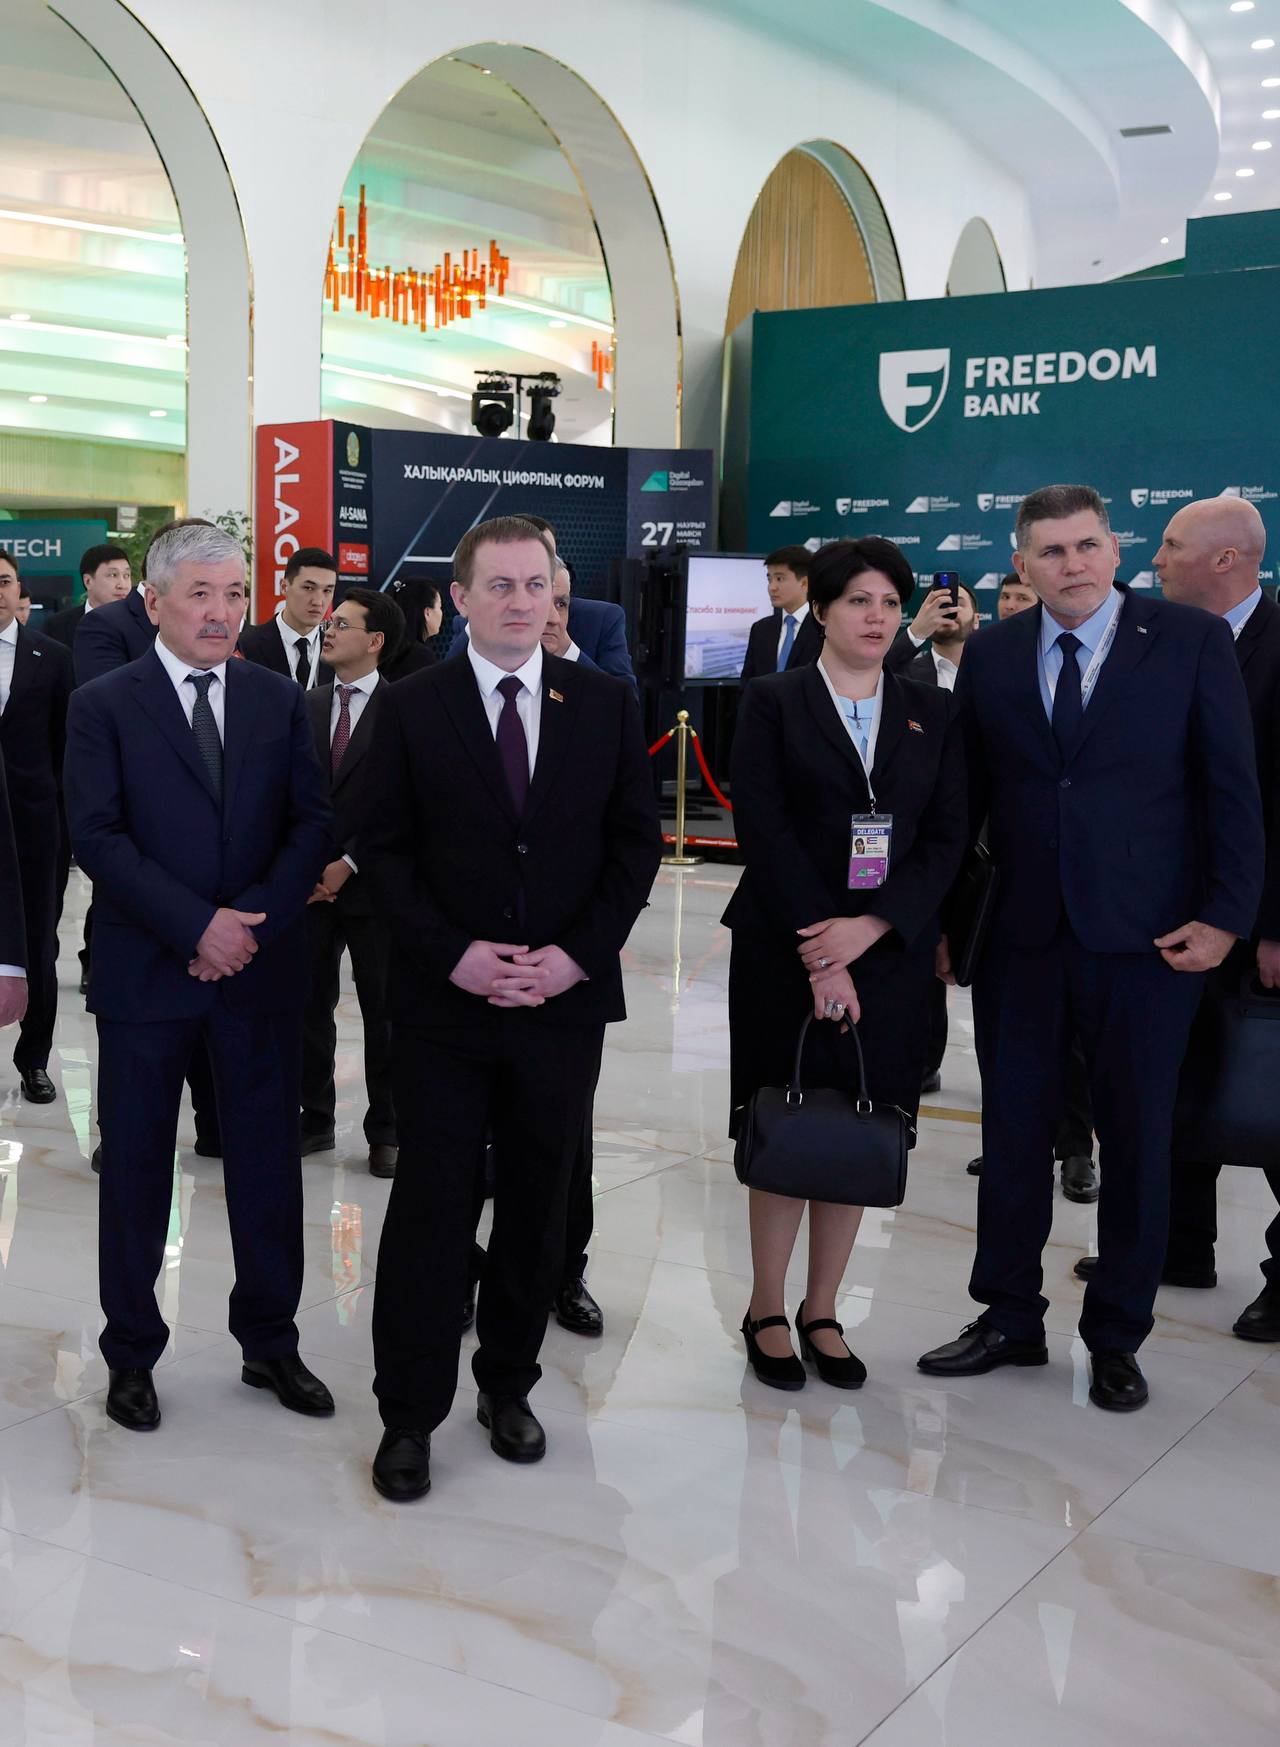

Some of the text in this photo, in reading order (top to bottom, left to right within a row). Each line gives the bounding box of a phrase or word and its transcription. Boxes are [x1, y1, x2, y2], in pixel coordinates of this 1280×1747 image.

[965, 345, 1157, 388] FREEDOM
[964, 391, 1041, 417] BANK
[404, 464, 604, 488] ХАЛЫҚАРАЛЫҚ ЦИФРЛЫҚ ФОРУМ
[641, 521, 674, 546] 27
